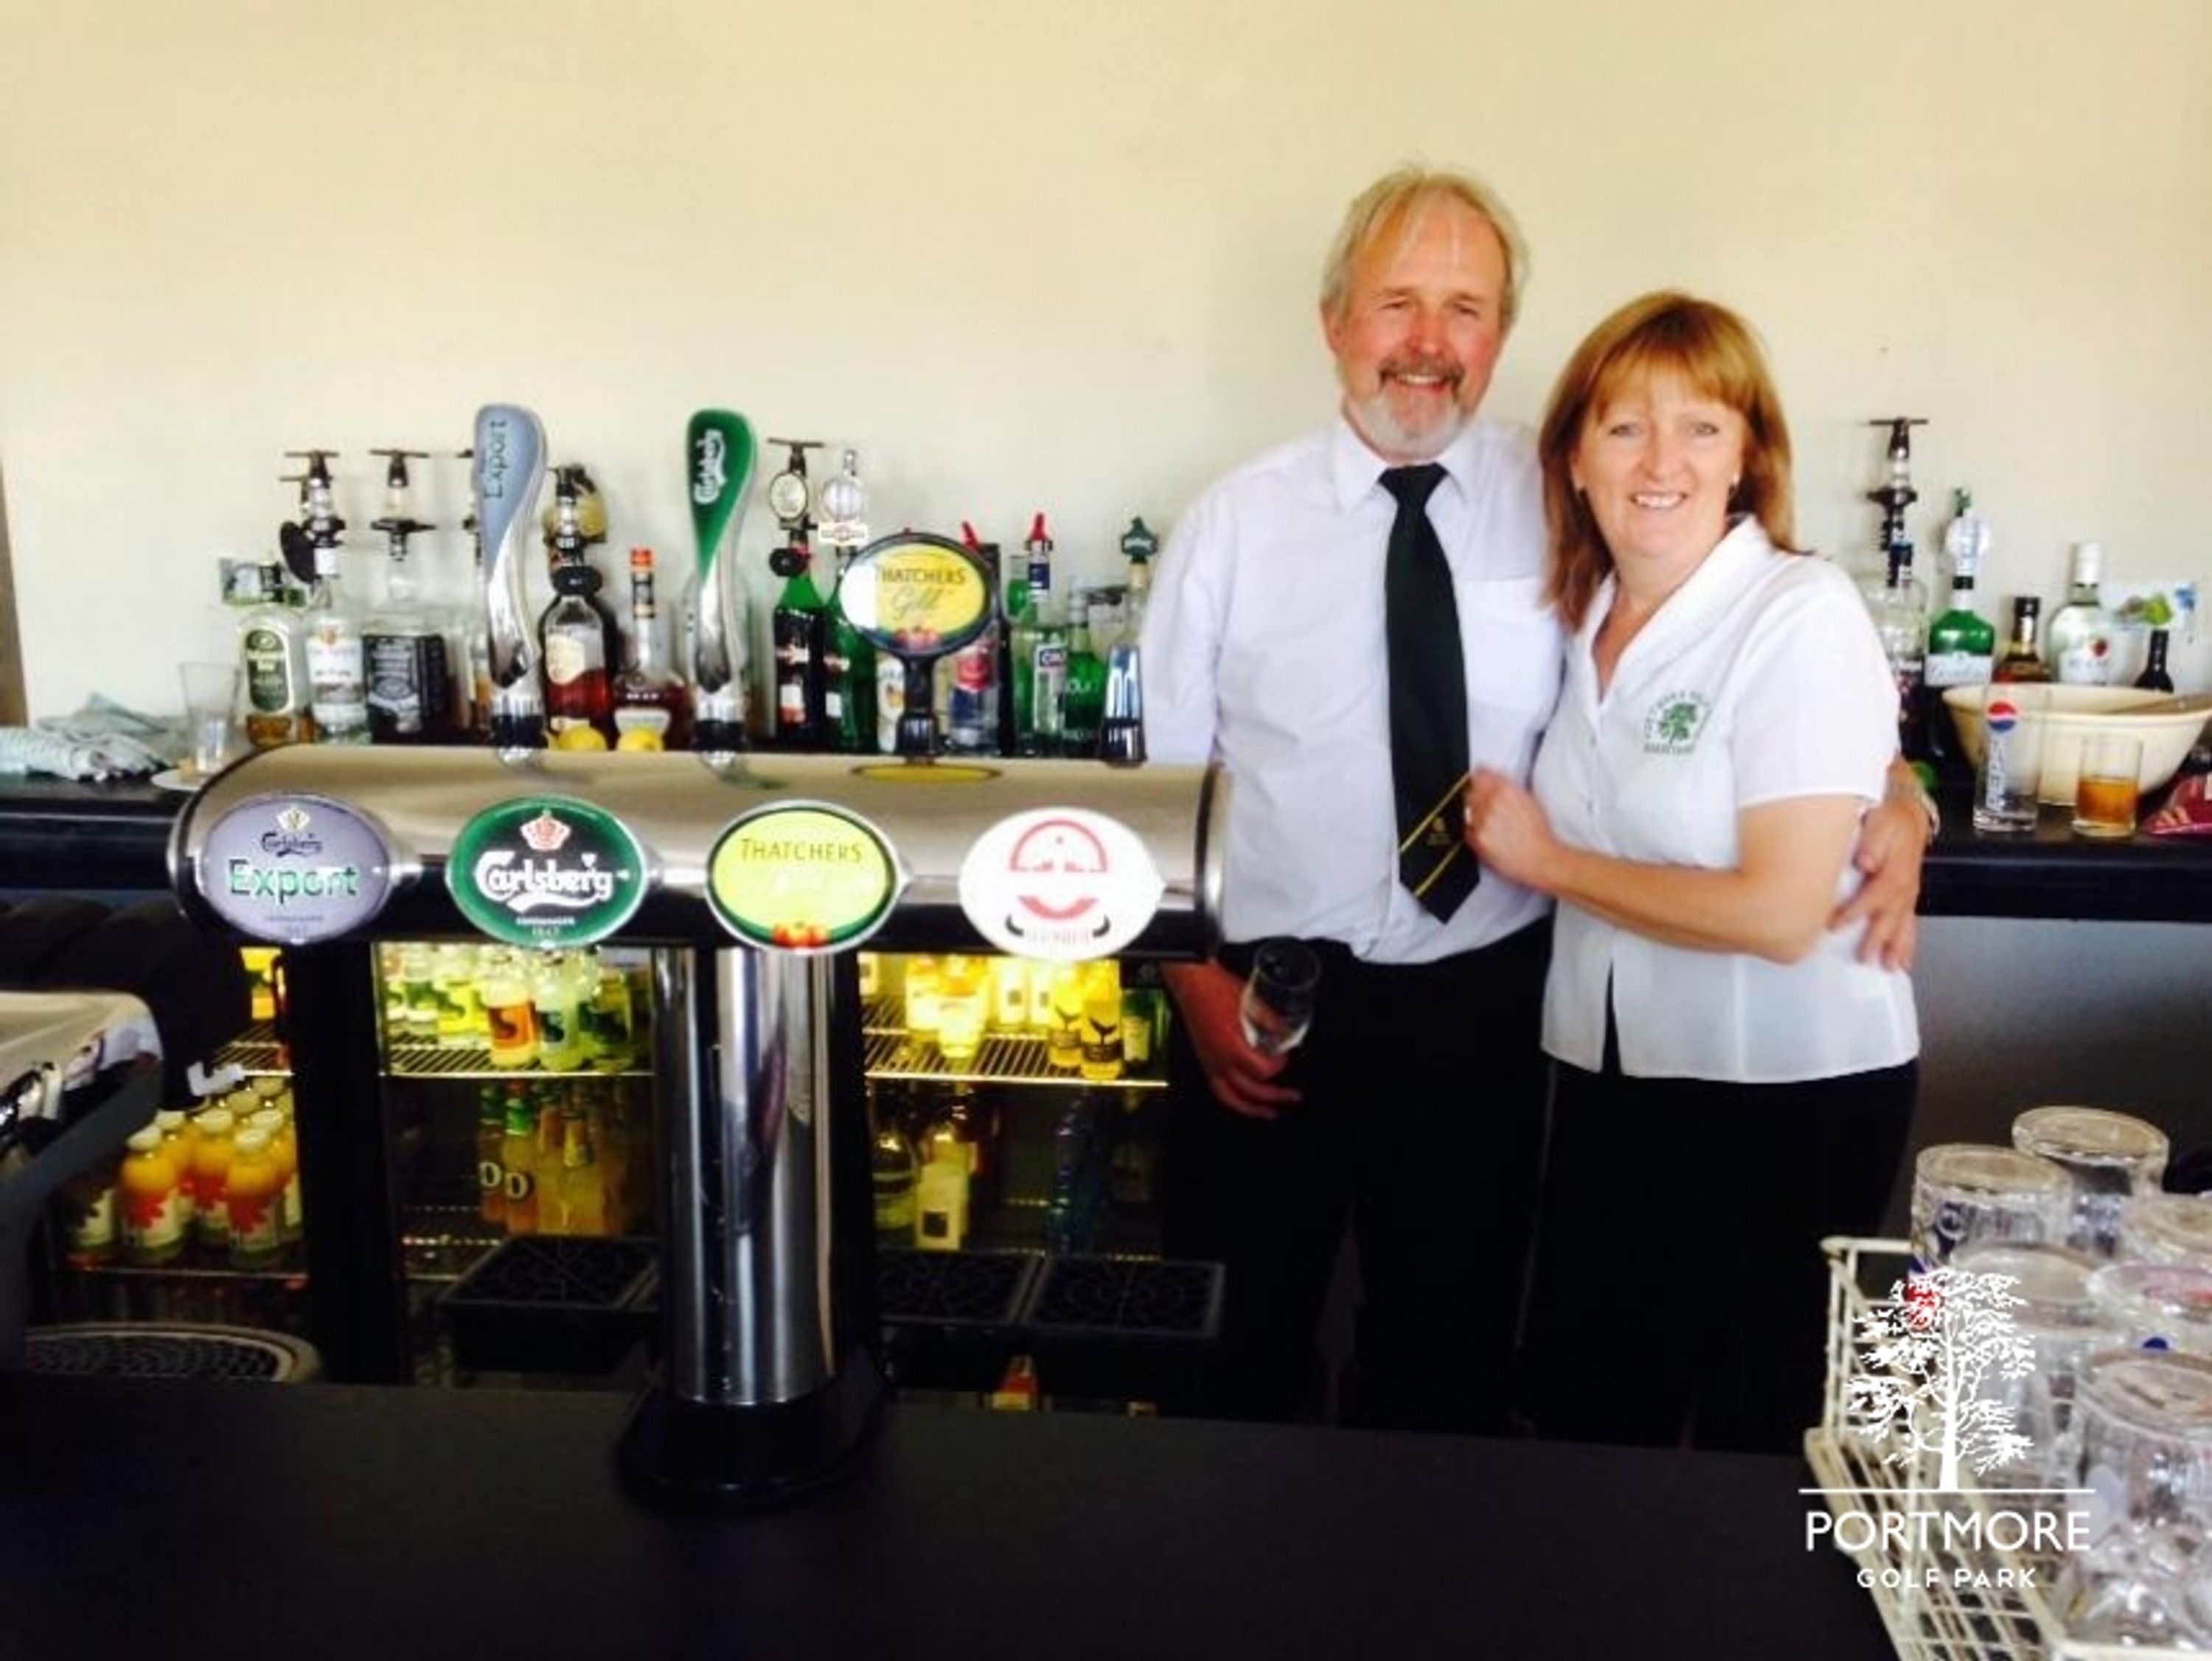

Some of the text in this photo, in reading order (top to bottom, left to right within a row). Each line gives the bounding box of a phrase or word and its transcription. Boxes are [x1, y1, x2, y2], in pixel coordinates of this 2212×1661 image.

[483, 419, 509, 499] Export
[740, 838, 863, 863] THATCHERS
[229, 859, 356, 904] Export
[475, 850, 613, 913] Carlsberg
